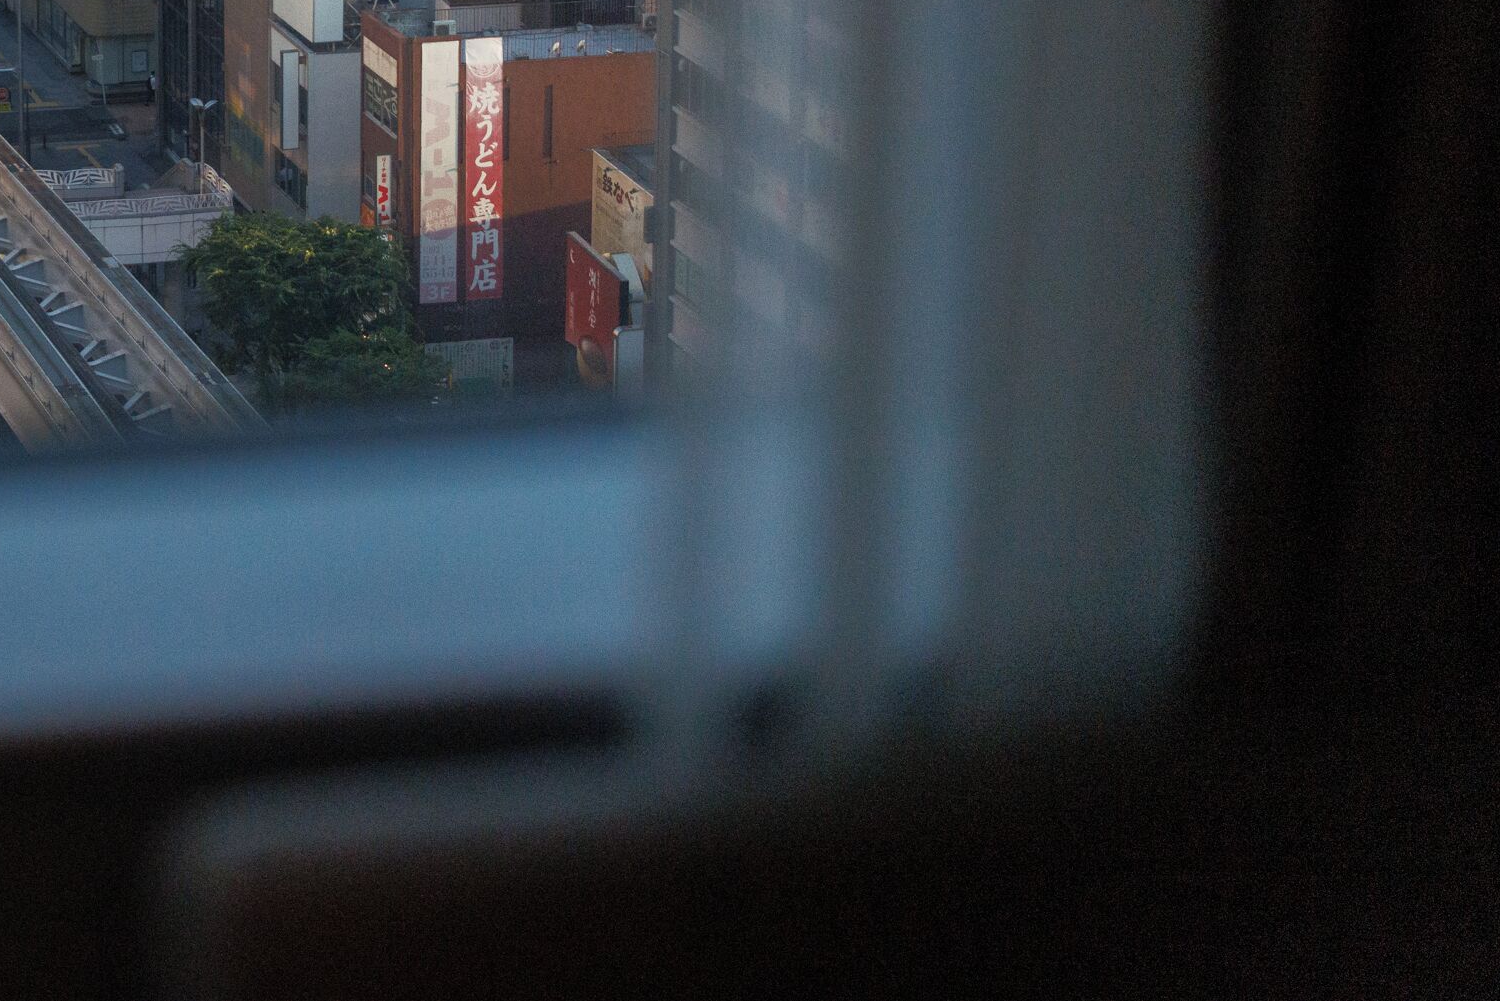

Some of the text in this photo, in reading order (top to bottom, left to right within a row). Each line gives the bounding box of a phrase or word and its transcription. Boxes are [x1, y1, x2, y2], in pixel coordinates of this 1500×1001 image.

[468, 81, 501, 292] 焼うどん専門店
